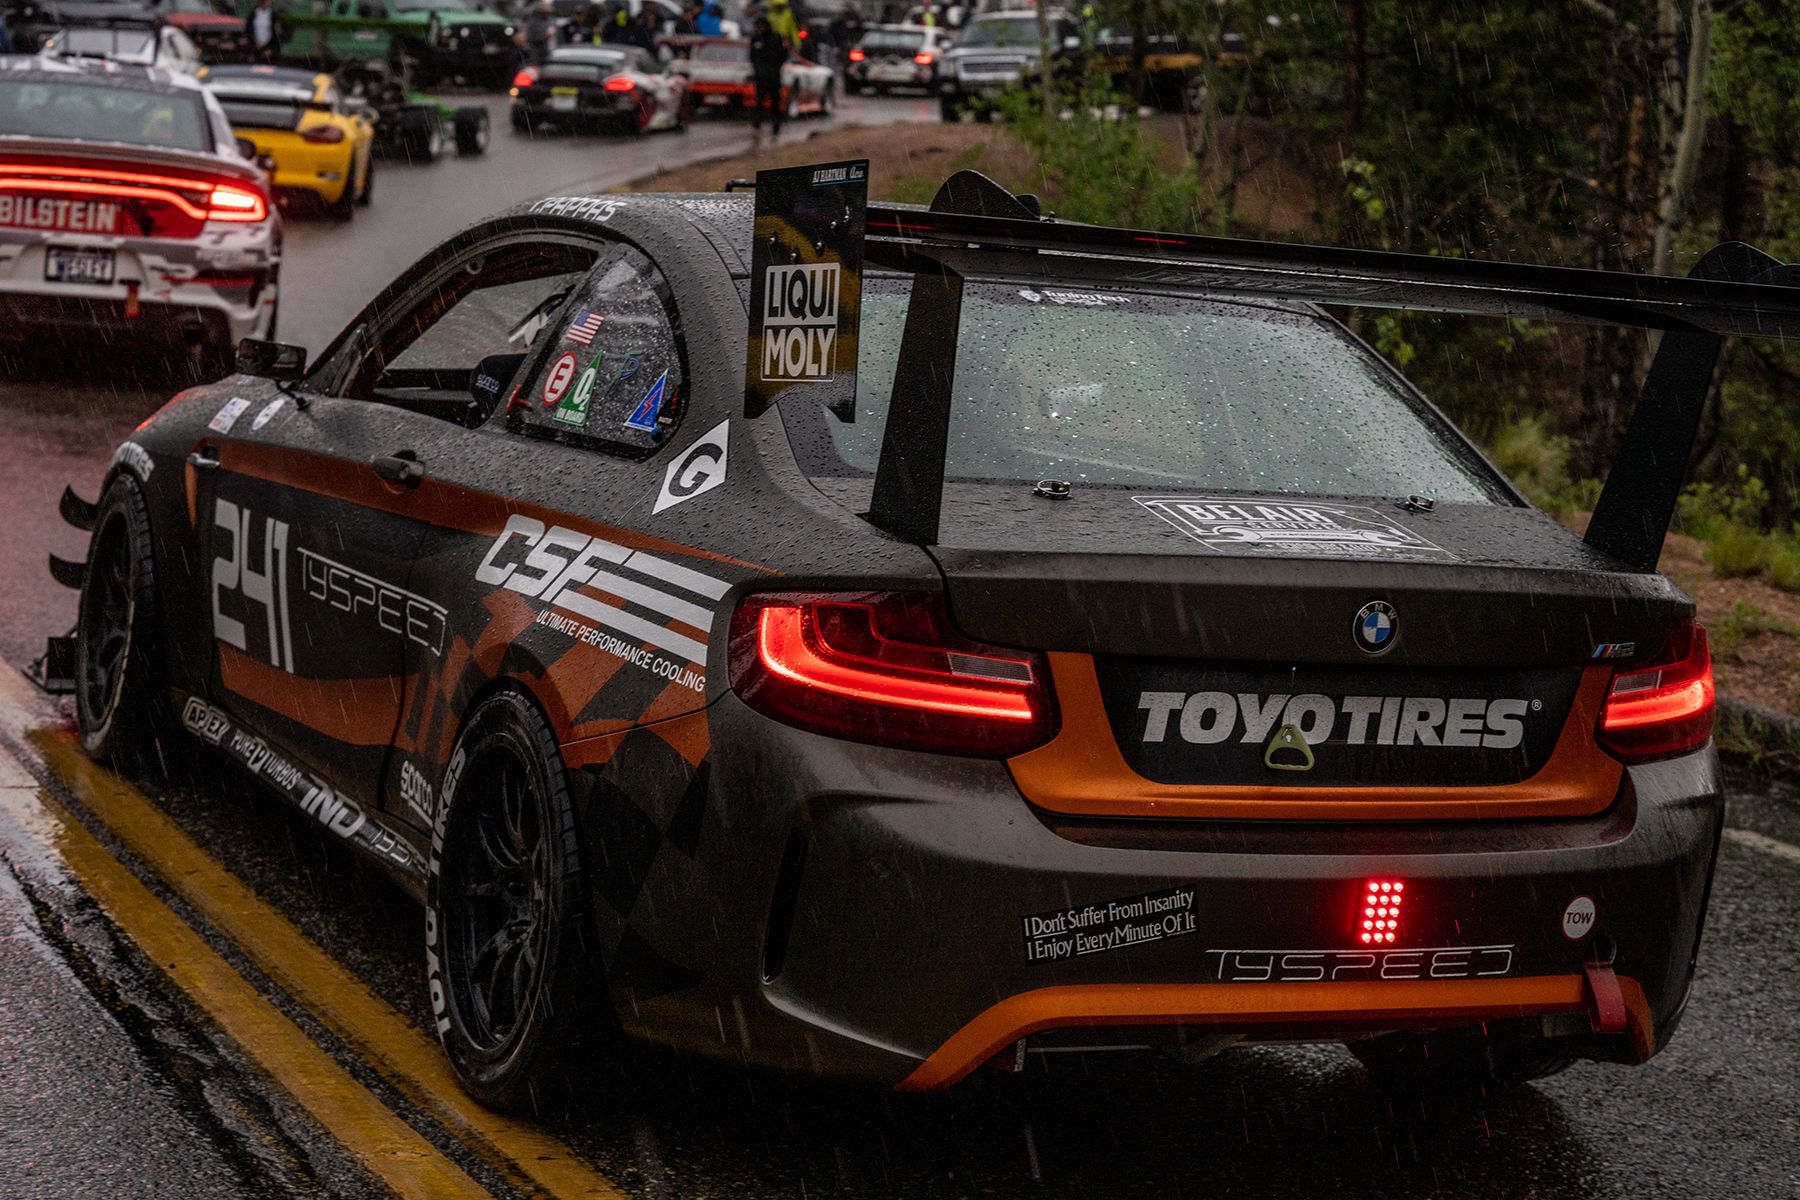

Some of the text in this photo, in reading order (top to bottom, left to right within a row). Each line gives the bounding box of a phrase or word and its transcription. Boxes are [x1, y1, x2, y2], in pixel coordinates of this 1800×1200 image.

[0, 194, 117, 231] BILSTEIN
[768, 269, 836, 320] LIQUI
[764, 327, 835, 377] MOLY
[668, 443, 723, 497] G
[1176, 504, 1335, 523] BELAIR
[475, 513, 634, 602] CSF
[536, 609, 706, 693] ULTIMATE PERFORMANCE COOLING
[1138, 691, 1336, 745] TOYO
[262, 750, 303, 791] TURBOS
[1024, 890, 1195, 937] I Don't Suffer From Insanity
[1027, 911, 1196, 960] I Enjoy Every Minute Of It
[1566, 910, 1593, 925] TOW
[425, 905, 451, 1035] TOYO
